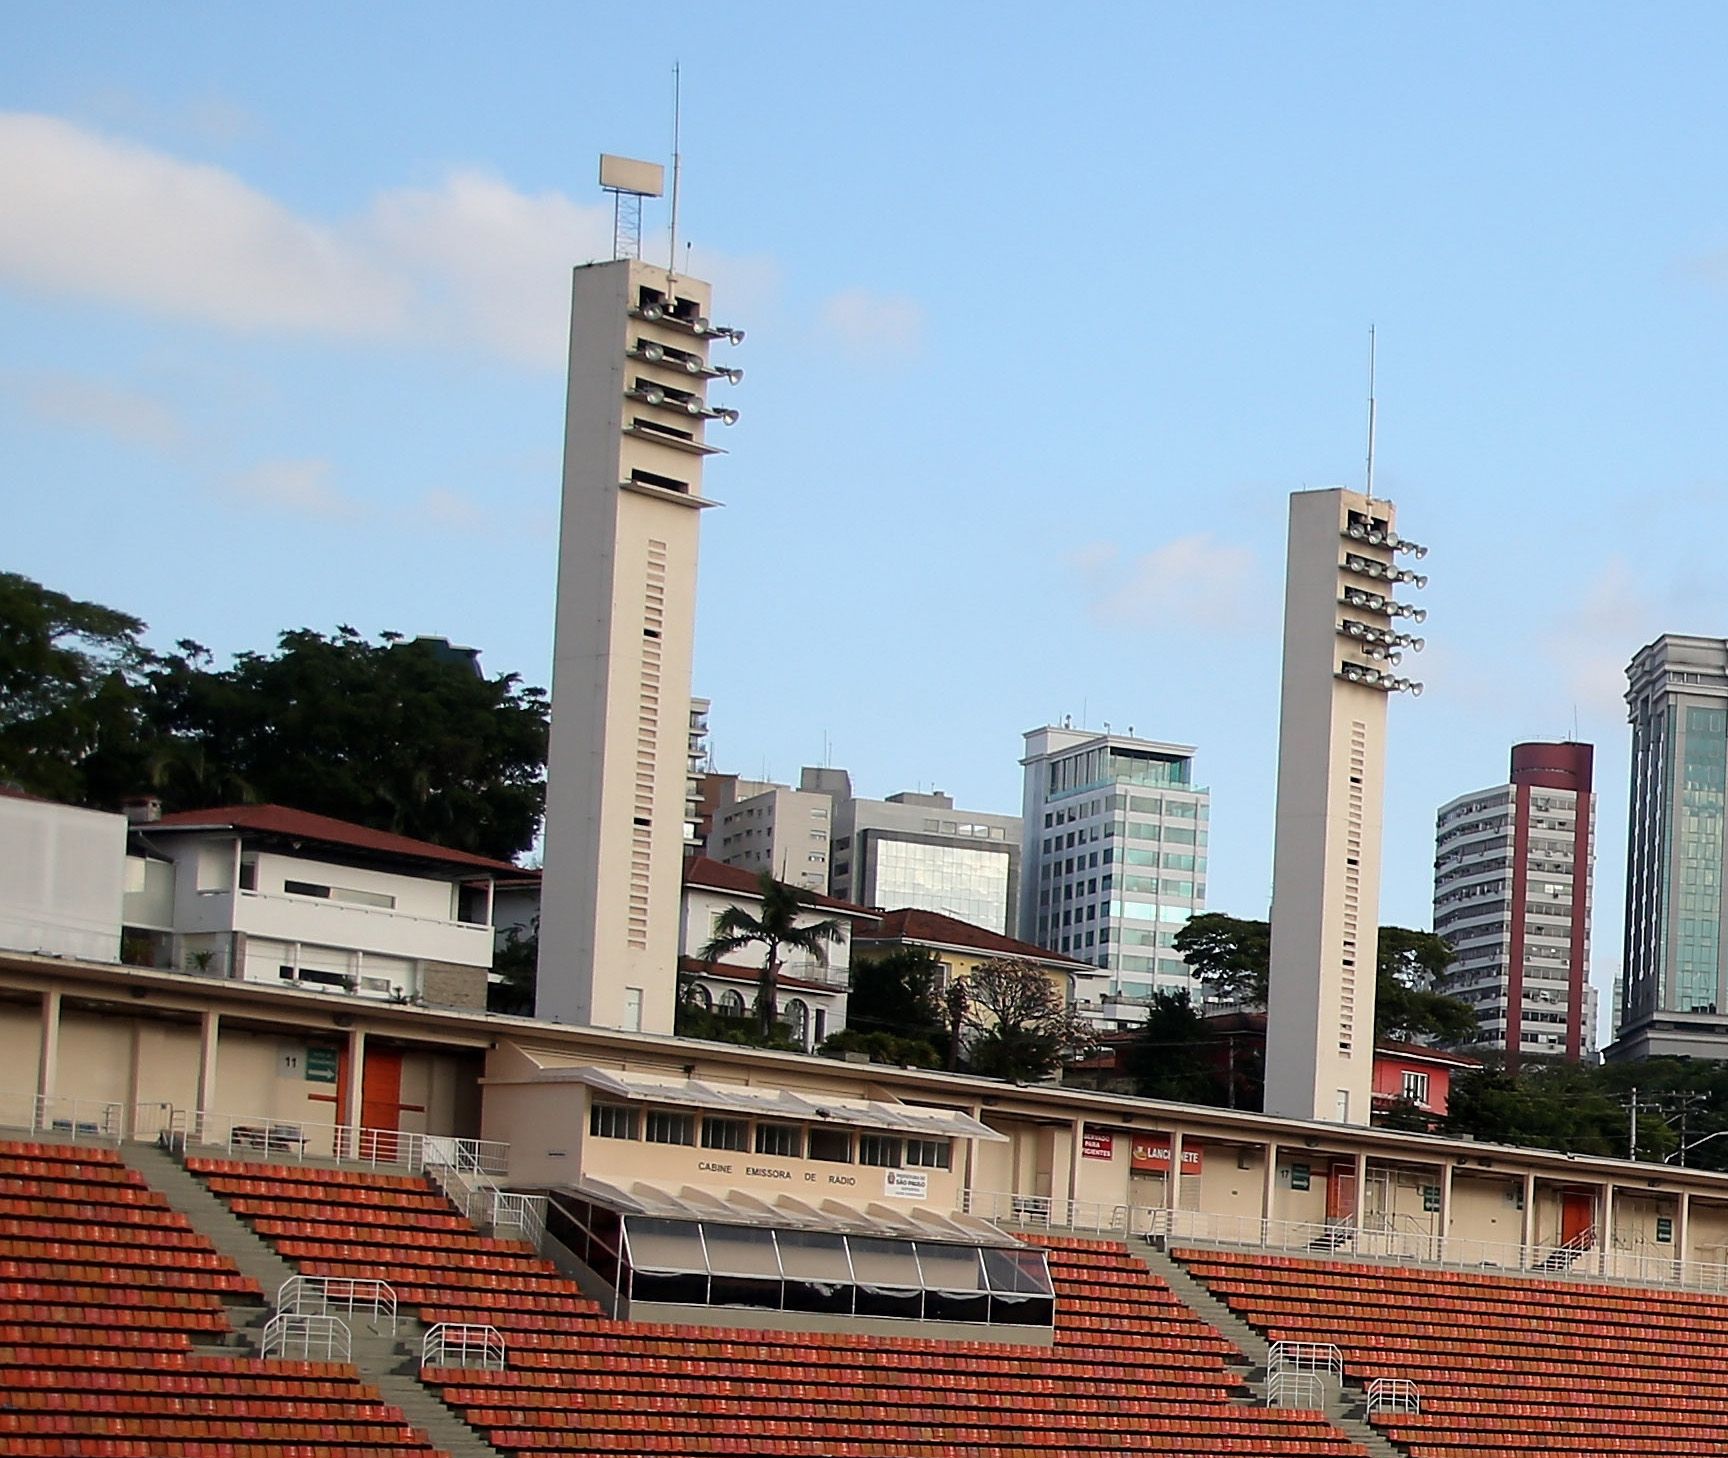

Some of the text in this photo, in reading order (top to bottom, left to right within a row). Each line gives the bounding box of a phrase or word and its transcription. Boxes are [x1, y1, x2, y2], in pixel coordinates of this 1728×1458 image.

[1147, 1147, 1199, 1163] LANCETE
[698, 1161, 856, 1186] CABINE EMISSORA DE RADIO
